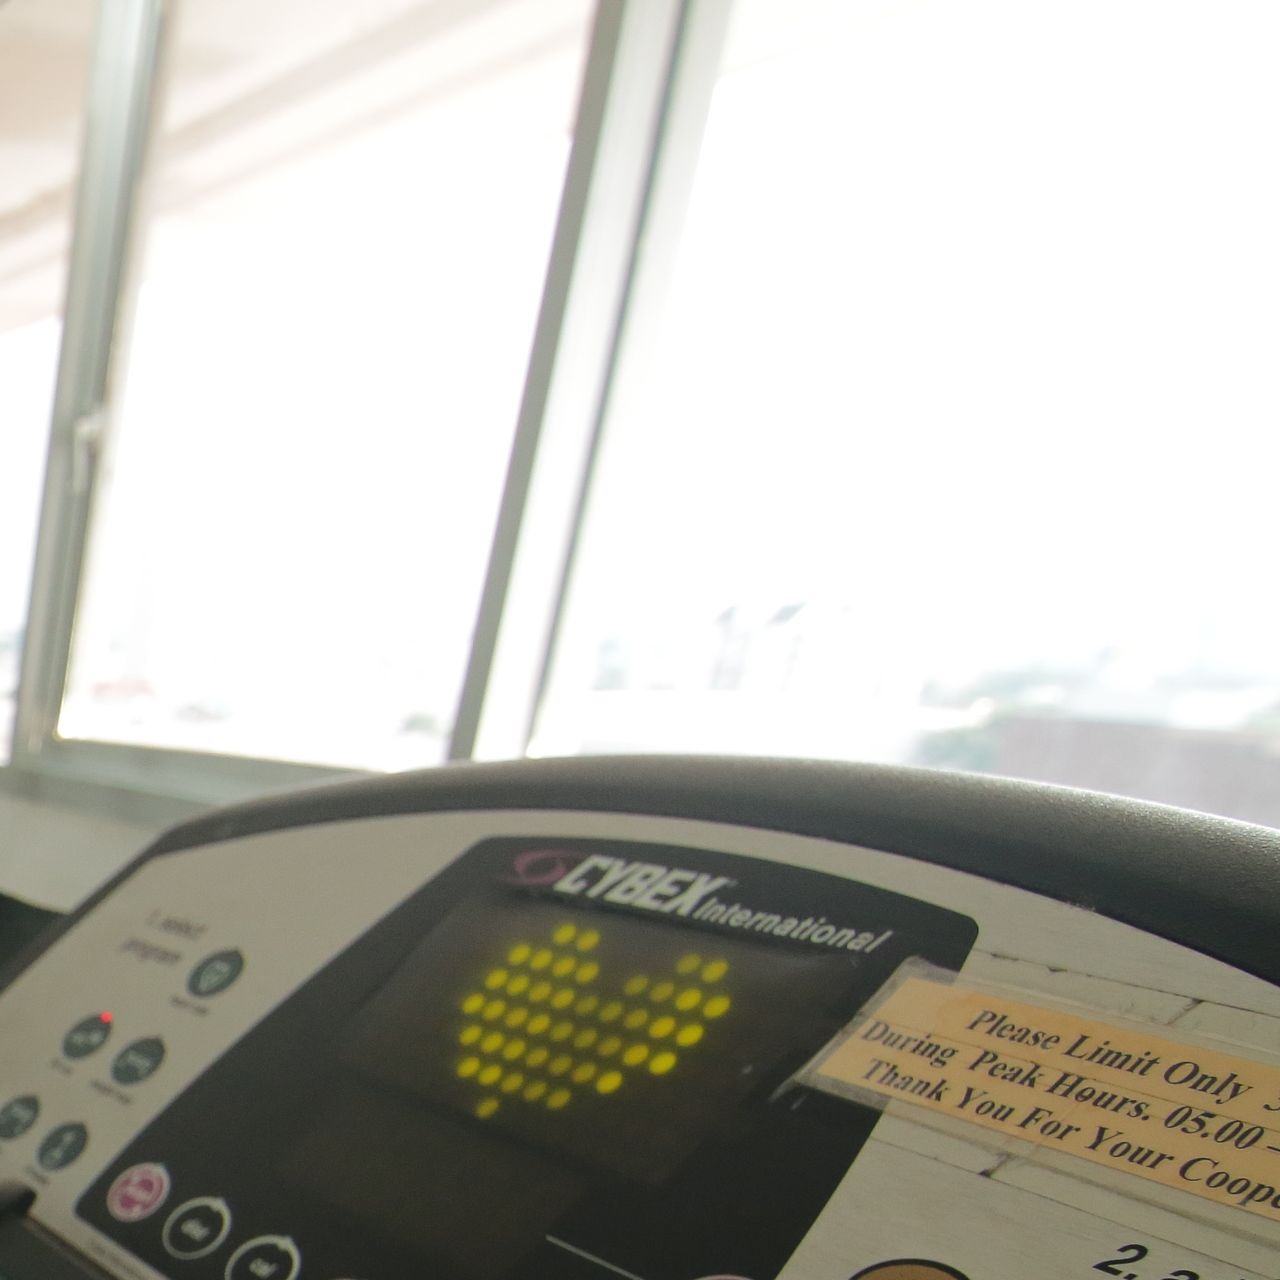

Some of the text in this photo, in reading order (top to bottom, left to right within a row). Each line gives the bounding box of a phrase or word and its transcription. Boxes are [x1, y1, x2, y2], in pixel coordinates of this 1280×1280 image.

[553, 854, 894, 954] CYBEX International
[861, 1020, 1265, 1150] During Peak Hours. 05.00
[965, 1009, 1060, 1051] Please
[1064, 1033, 1161, 1077] Limit
[1163, 1060, 1254, 1105] Only
[862, 1057, 952, 1102] Thank
[955, 1086, 1015, 1122] You
[1016, 1106, 1081, 1141] For
[1086, 1125, 1175, 1170] Your
[1092, 1243, 1149, 1280] 2.
